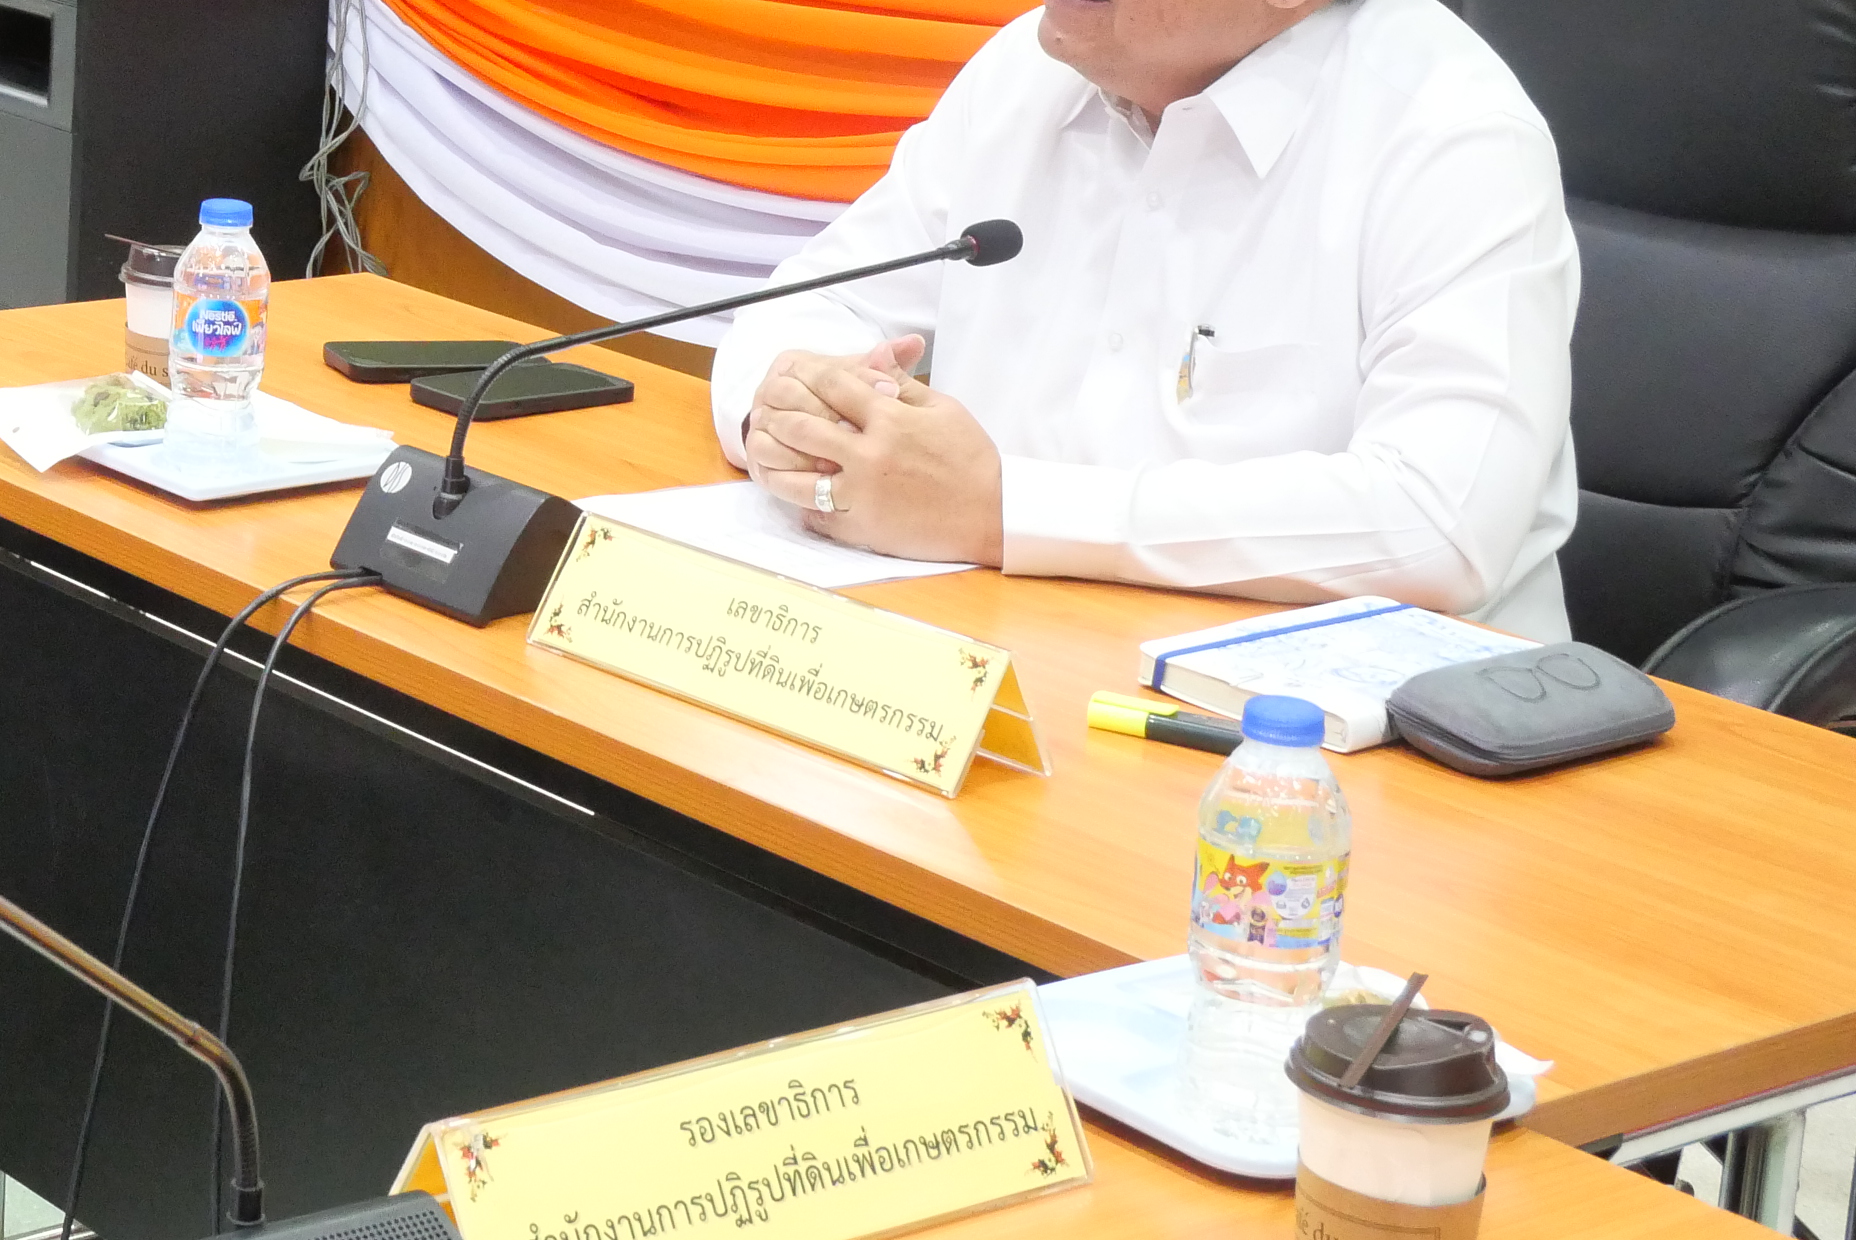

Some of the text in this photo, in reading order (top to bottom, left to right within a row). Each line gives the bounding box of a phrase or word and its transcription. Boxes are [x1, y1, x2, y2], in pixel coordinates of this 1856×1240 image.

[726, 597, 823, 645] เลขาธิการ
[576, 591, 945, 743] สำนักงานการปฏิรูปที่ดินเพื่อเกษตรกรรม
[679, 1078, 860, 1147] รองเลขาธิการ
